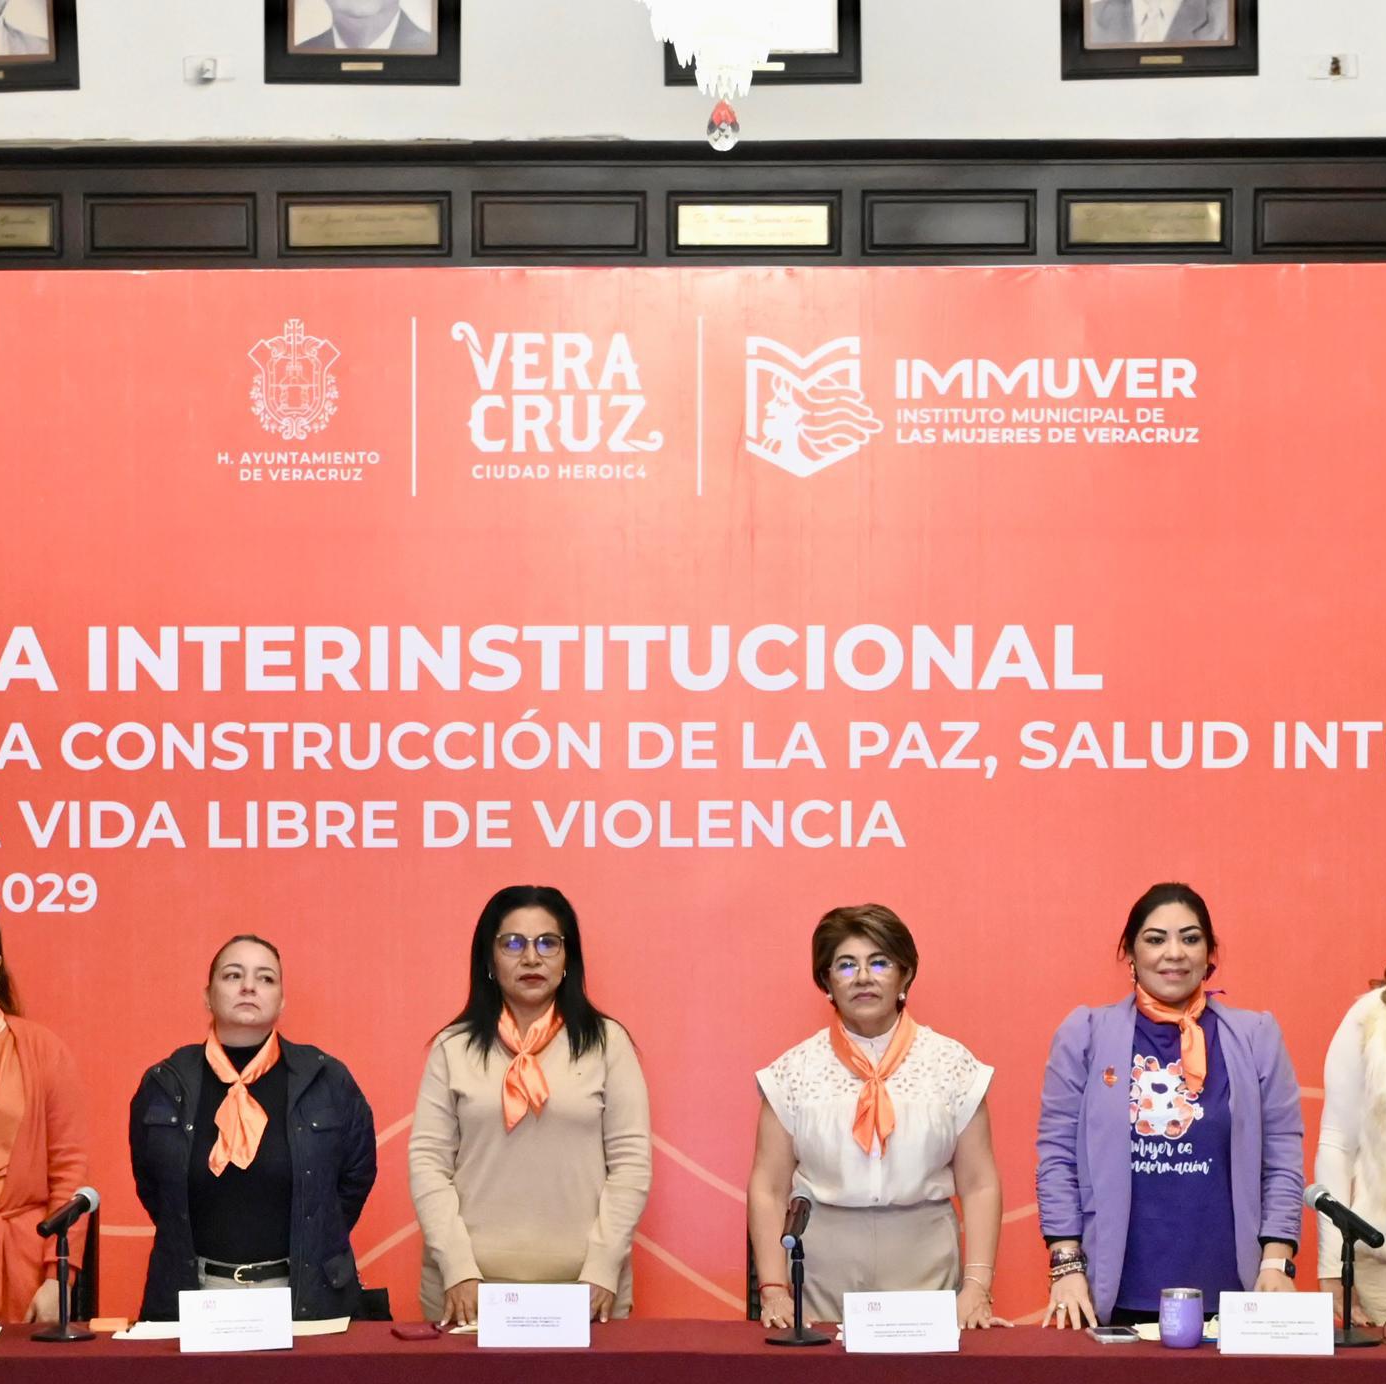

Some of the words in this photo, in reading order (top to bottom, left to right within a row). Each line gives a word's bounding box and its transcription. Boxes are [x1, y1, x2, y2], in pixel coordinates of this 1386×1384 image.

[451, 321, 643, 391] VERA
[895, 358, 1198, 401] IMMUVER
[467, 394, 665, 453] CRUZ
[896, 408, 1007, 425] INSTITUTO
[1012, 408, 1131, 425] MUNICIPAL
[1137, 409, 1165, 425] DE
[896, 428, 938, 444] LAS
[943, 428, 1043, 444] MUJERES
[1048, 428, 1078, 444] DE
[1083, 428, 1200, 444] VERACRUZ
[216, 451, 235, 466] H.
[239, 450, 382, 466] AYUNTAMIENTO
[239, 467, 264, 483] DE
[268, 467, 365, 483] VERACRUZ
[470, 464, 551, 481] CIUDAD
[89, 624, 1105, 694] INTERINSTITUCIONAL
[61, 708, 605, 773] CONSTRUCCIÓN
[627, 720, 721, 772] DE
[742, 720, 829, 772] LA
[848, 719, 1000, 781] PAZ,
[1019, 720, 1251, 772] SALUD
[18, 800, 188, 850] VIDA
[208, 800, 400, 850] LIBRE
[423, 800, 514, 850] DE
[532, 799, 908, 850] VIOLENCIA
